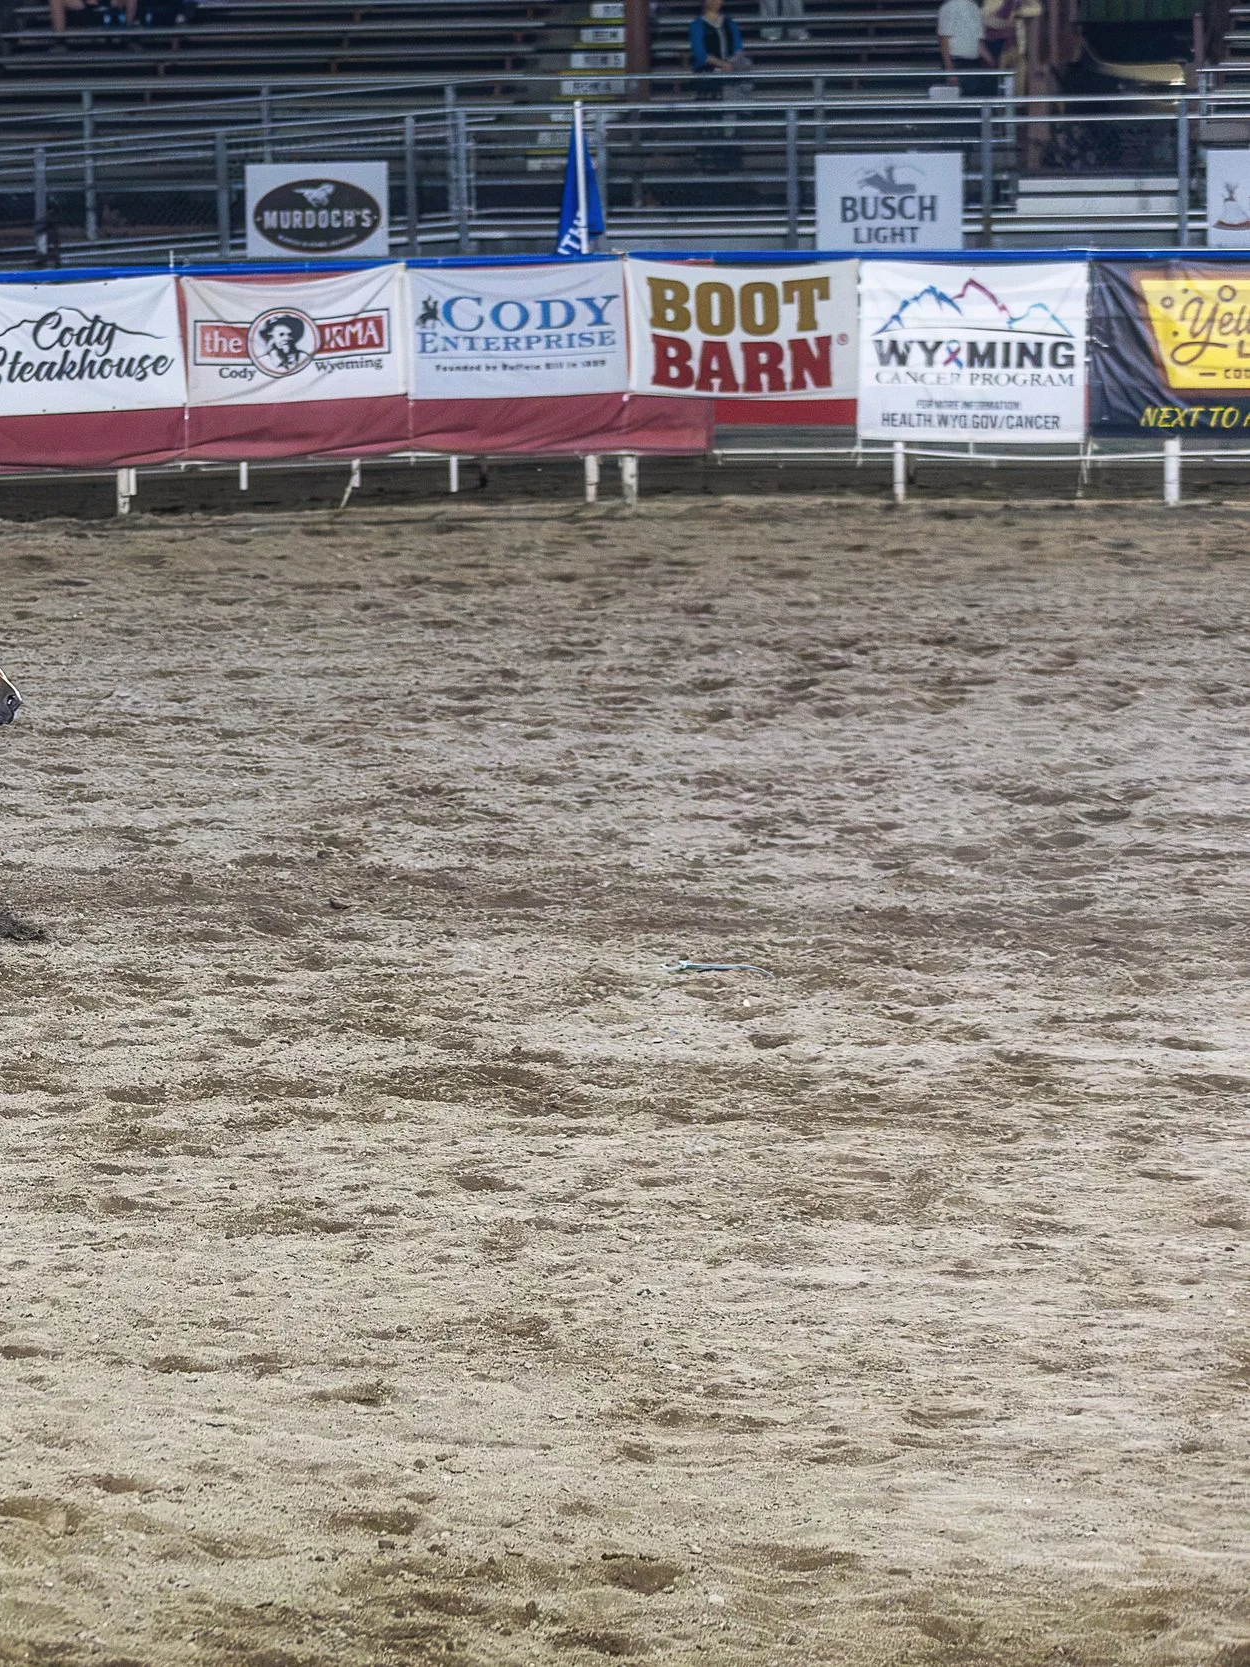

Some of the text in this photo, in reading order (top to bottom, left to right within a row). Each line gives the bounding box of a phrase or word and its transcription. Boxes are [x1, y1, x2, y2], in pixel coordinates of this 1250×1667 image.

[263, 208, 372, 229] MURDOCH'S
[840, 195, 938, 223] BUSCH
[853, 226, 921, 244] LIGHT
[442, 295, 620, 332] CODY
[647, 276, 831, 337] BOOT
[32, 311, 117, 358] Cody
[203, 321, 380, 353] the IRMA
[416, 330, 616, 354] ENTERPRISE
[218, 357, 383, 381] Cody Wyoming
[650, 333, 833, 394] BARN
[875, 371, 1075, 387] CANCER PROGRAM
[881, 412, 1061, 430] HEALTH.WYO.GOV/CANCER
[1140, 406, 1205, 428] NEXT
[1209, 406, 1240, 429] TO
